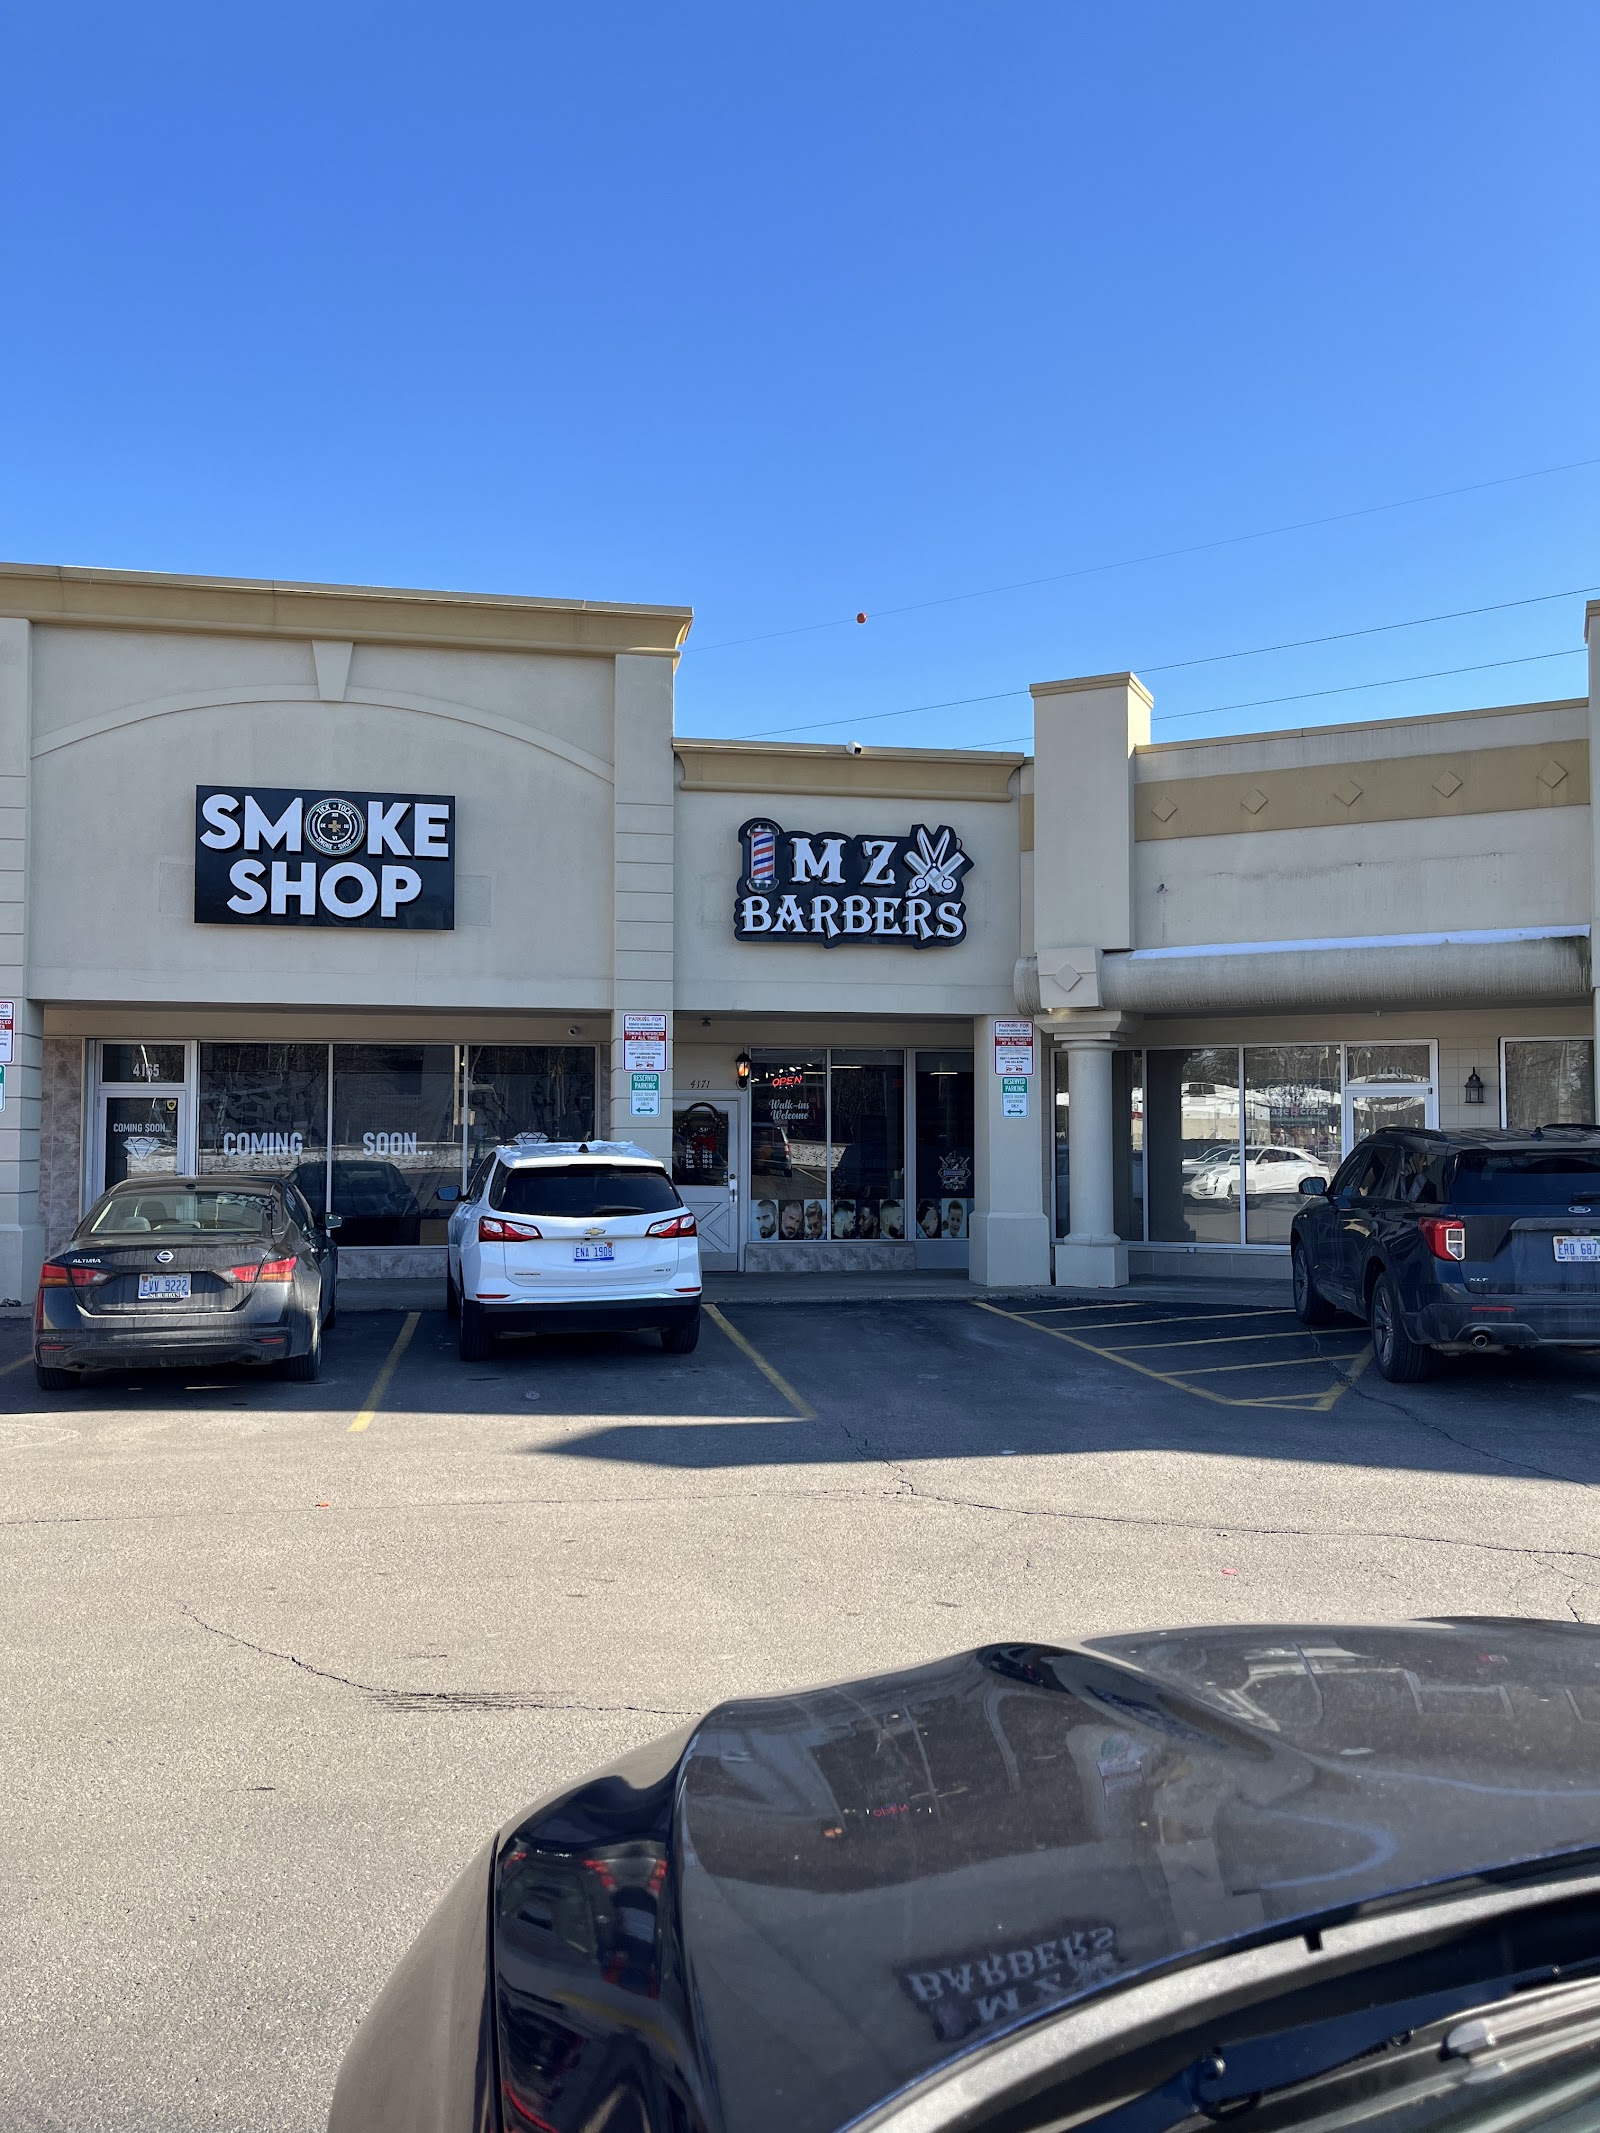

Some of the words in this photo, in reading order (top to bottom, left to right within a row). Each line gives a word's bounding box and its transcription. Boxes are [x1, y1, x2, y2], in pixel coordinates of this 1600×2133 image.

[316, 804, 331, 815] TICK
[338, 804, 354, 816] TOCK
[789, 838, 847, 885] M
[860, 840, 898, 886] Z
[227, 858, 422, 919] SHOP
[740, 894, 964, 940] BARBERS
[133, 1063, 160, 1077] 4165
[690, 1080, 711, 1089] 4171
[771, 1075, 803, 1088] OPEN
[768, 1099, 810, 1110] Walk-ins
[770, 1110, 809, 1120] Welcome
[113, 1123, 142, 1132] COMING
[223, 1132, 303, 1156] COMING
[575, 1247, 590, 1258] ENA
[594, 1246, 613, 1258] 1908
[1580, 1243, 1600, 1255] 687
[142, 1280, 160, 1292] EVV
[165, 1280, 187, 1292] 9222
